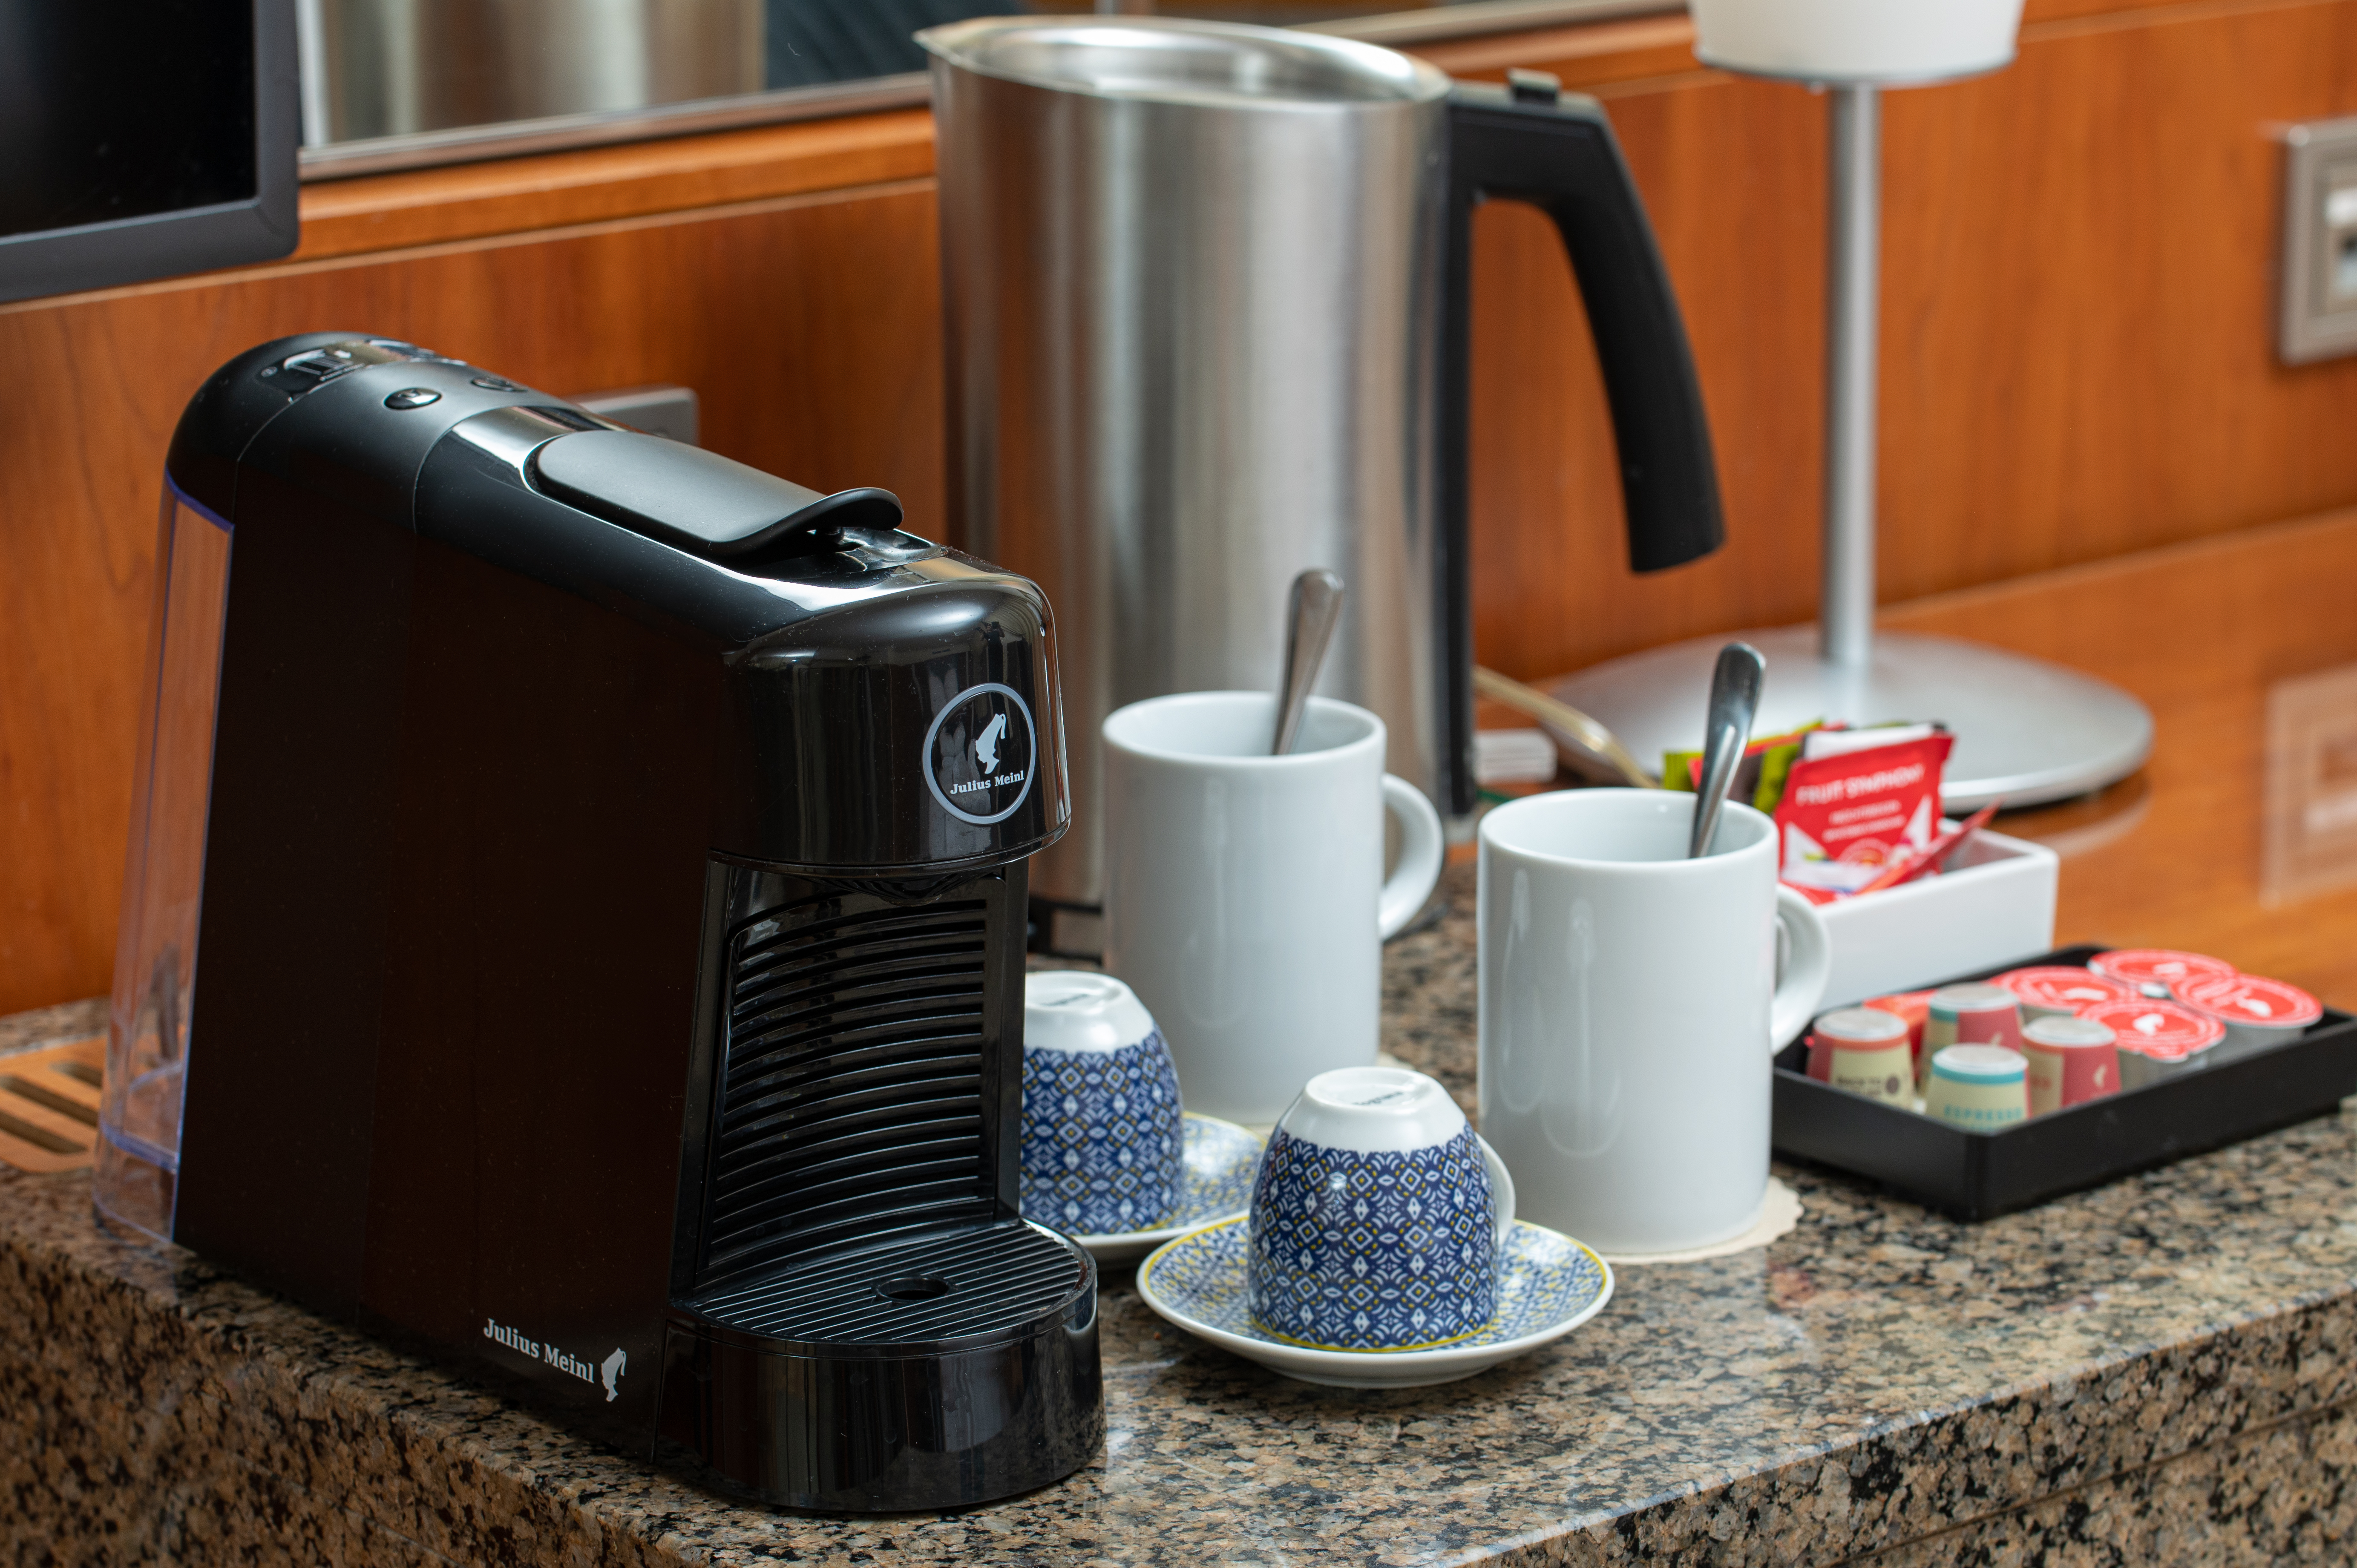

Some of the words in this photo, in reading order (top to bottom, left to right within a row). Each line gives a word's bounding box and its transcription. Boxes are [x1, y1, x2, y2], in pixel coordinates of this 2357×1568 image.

[950, 779, 991, 794] Julius
[994, 771, 1024, 787] Meinl
[1795, 779, 1845, 807] FRUIT
[483, 1318, 540, 1358] Julius
[544, 1343, 594, 1384] Meinl
